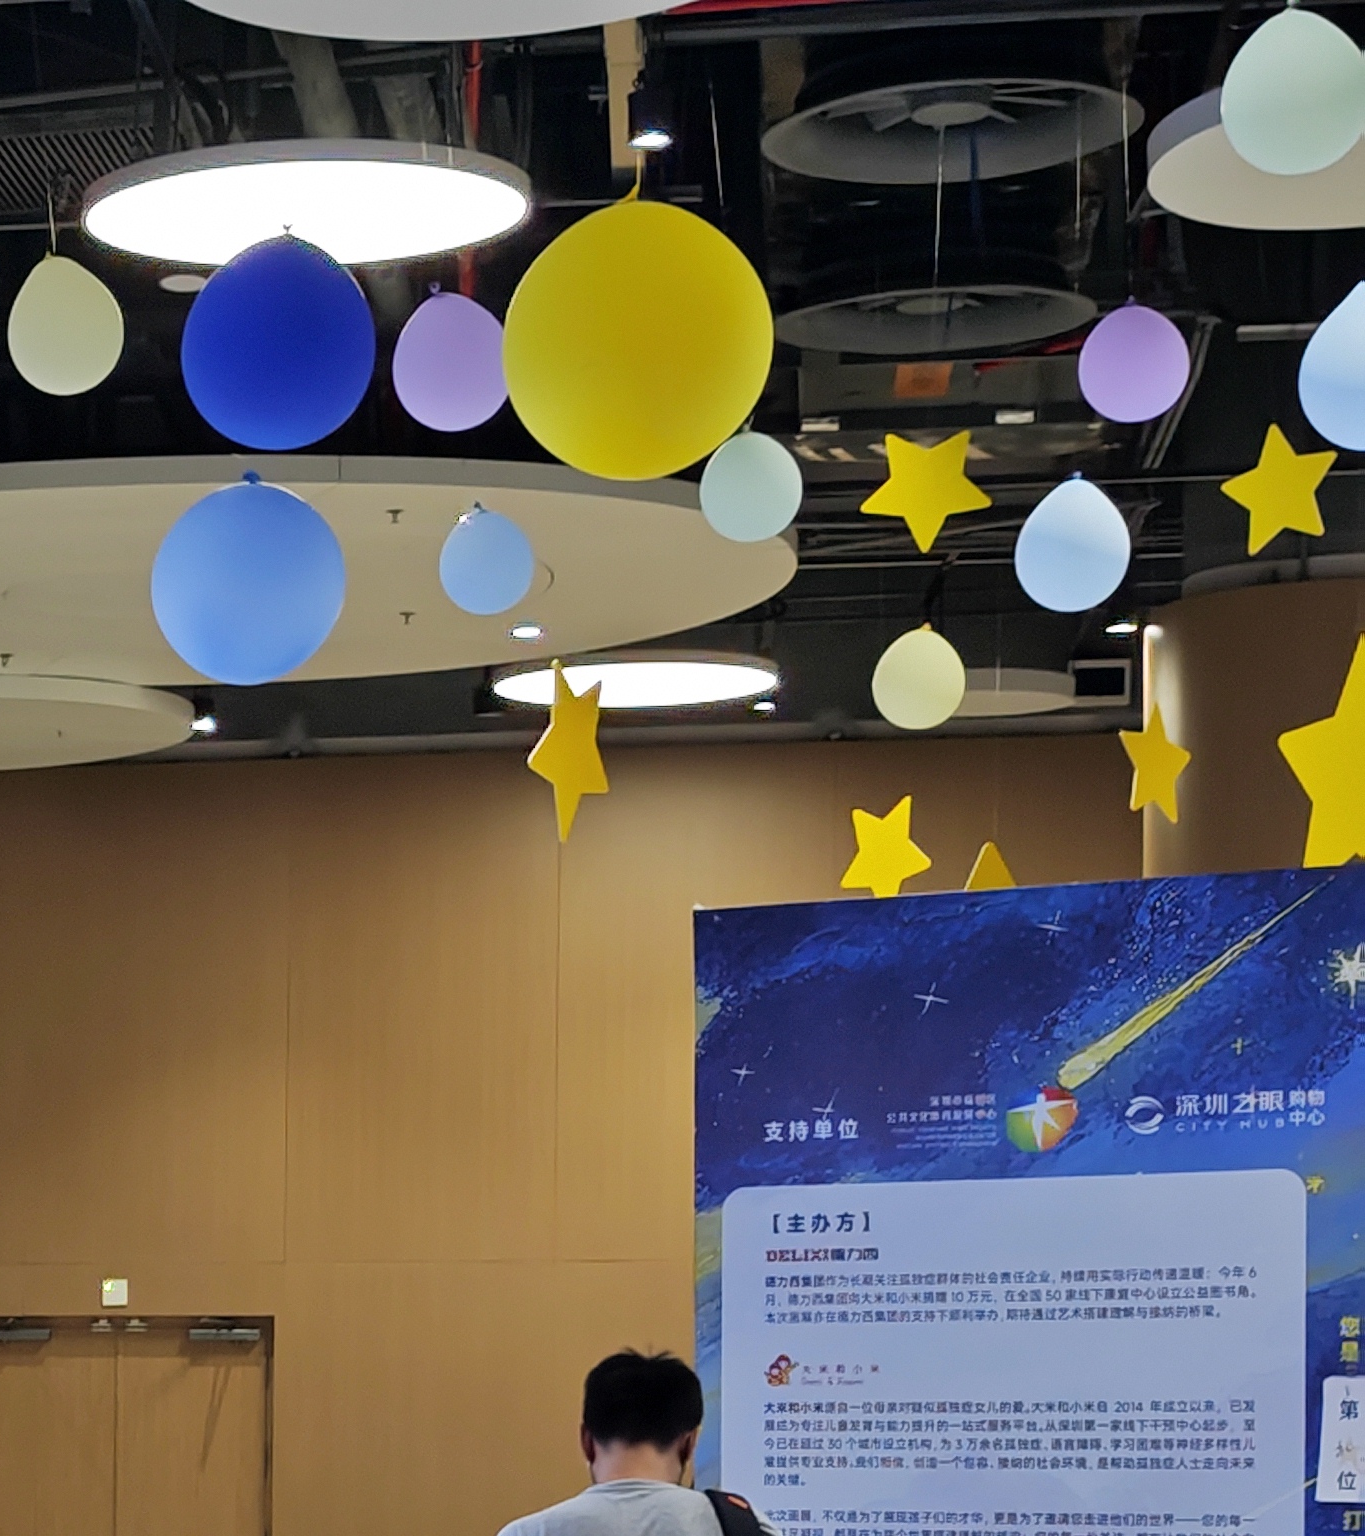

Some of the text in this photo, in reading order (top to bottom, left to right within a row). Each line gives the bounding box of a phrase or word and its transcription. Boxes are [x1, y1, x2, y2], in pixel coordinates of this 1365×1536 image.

[1175, 1089, 1326, 1117] 深圳之眼 购物
[1175, 1119, 1285, 1133] CITY HUB
[1289, 1108, 1326, 1127] 中心
[763, 1118, 859, 1143] 支持单位
[772, 1211, 871, 1234] 【主办方】
[1114, 1401, 1144, 1413] 2014
[1336, 1400, 1359, 1491] 第 位
